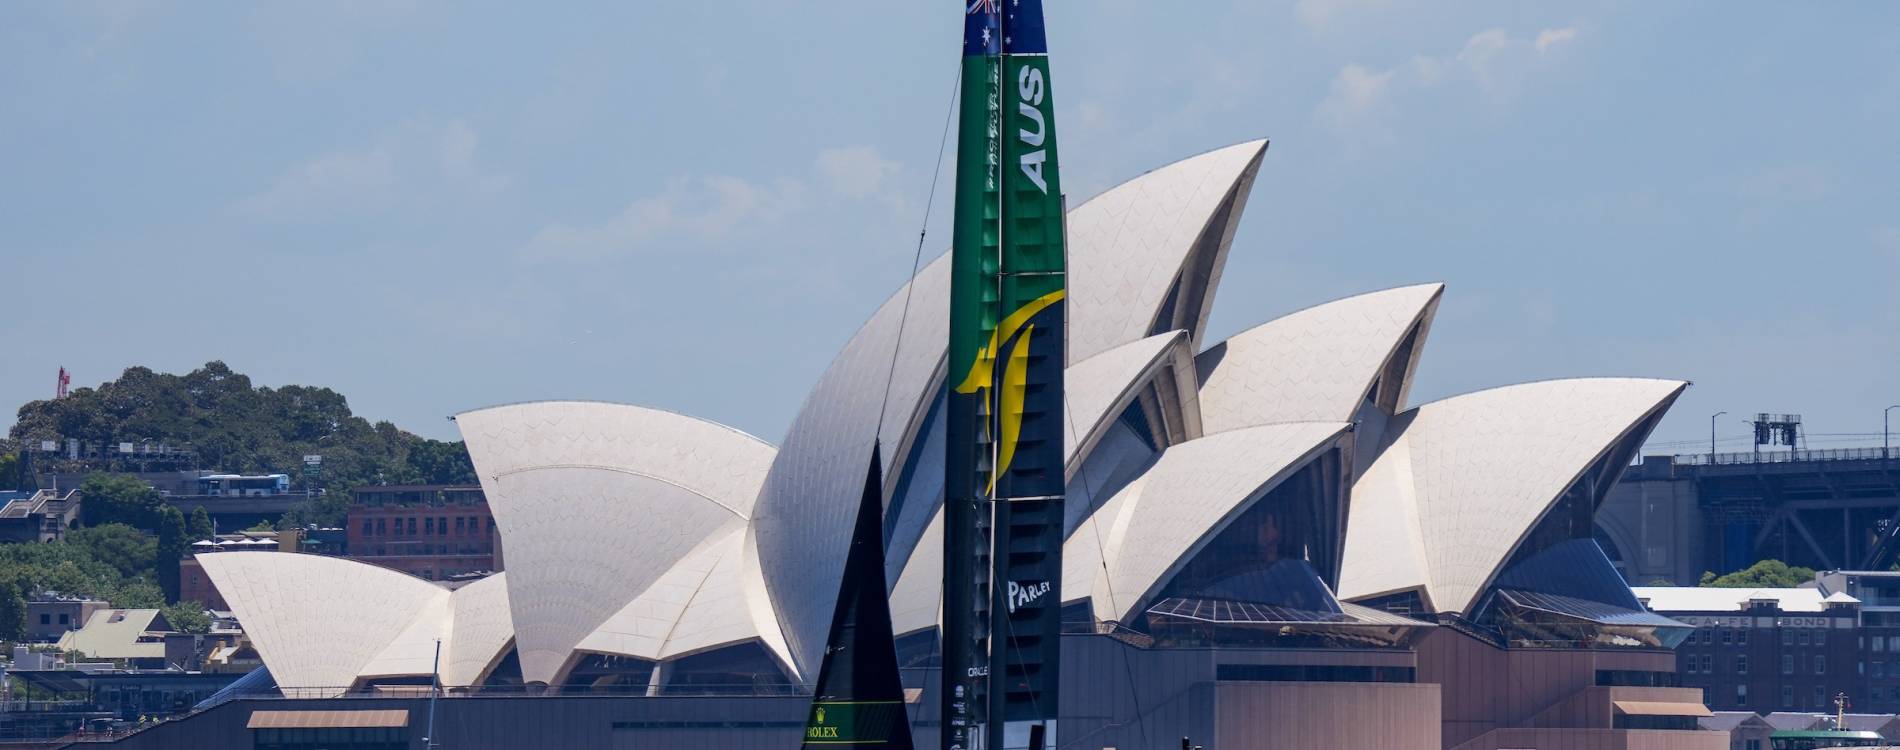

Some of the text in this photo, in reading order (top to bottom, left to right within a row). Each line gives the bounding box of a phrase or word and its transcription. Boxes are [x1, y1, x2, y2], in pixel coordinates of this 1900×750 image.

[1019, 64, 1047, 195] AUS
[1008, 581, 1050, 613] PARLEY
[1782, 617, 1826, 626] BOND
[807, 726, 838, 738] ROLEX
